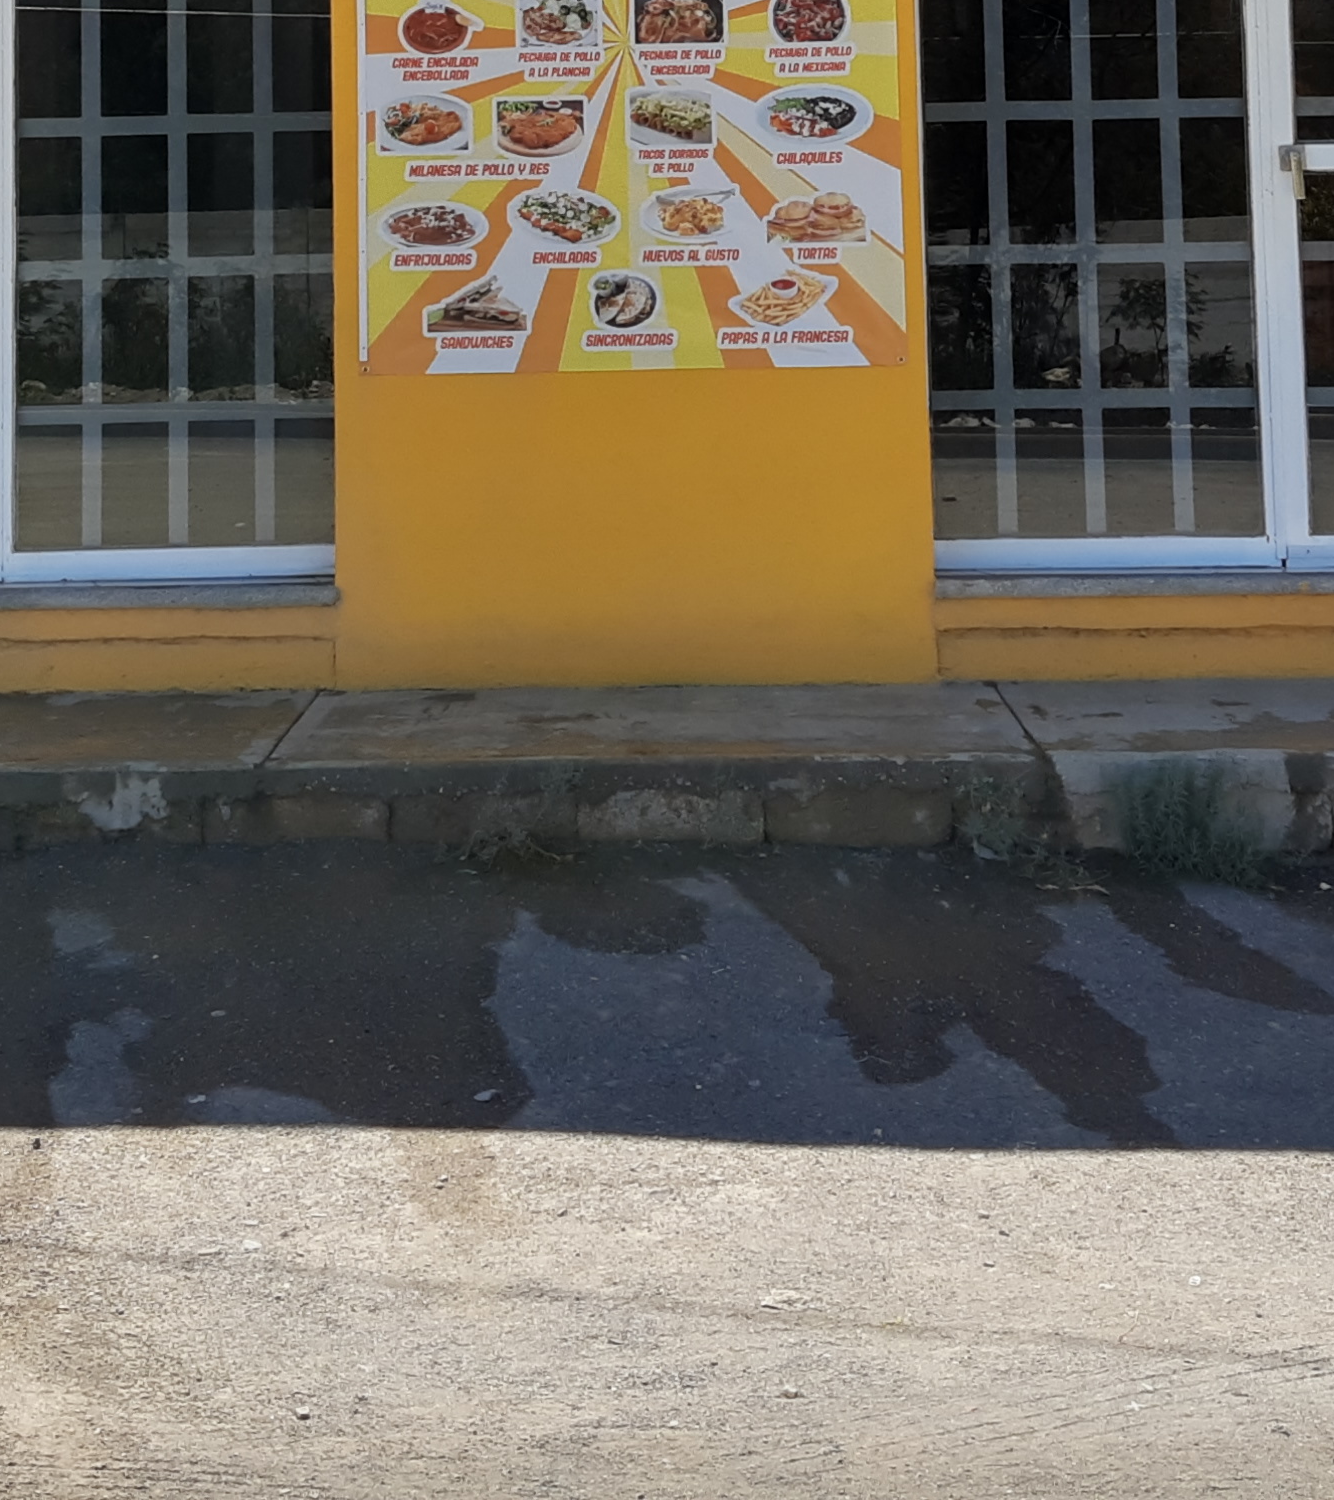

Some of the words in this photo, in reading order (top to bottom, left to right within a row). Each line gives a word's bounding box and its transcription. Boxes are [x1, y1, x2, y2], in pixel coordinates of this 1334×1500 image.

[518, 52, 557, 63] PECHUGA
[560, 52, 572, 62] DE
[574, 51, 601, 62] POLLO
[639, 50, 679, 61] PECHUGA
[681, 50, 693, 61] DE
[694, 49, 722, 60] POLLO
[769, 48, 809, 59] PECHUGA
[811, 47, 823, 57] DE
[825, 46, 852, 57] POLLO
[392, 57, 423, 69] CARNE
[426, 56, 479, 68] ENCHILADA
[779, 63, 786, 74] A
[788, 63, 800, 73] LA
[802, 62, 846, 73] MEXICANA
[402, 69, 469, 82] ENCEBOLLADA
[528, 68, 535, 78] A
[537, 68, 550, 77] LA
[551, 66, 591, 77] PLANCHA
[650, 64, 710, 76] ENCEBOLLADA
[638, 149, 665, 160] TACOS
[668, 149, 709, 160] DORADOS
[777, 152, 842, 166] CHILAQUILES
[409, 163, 461, 177] MILANESA
[464, 163, 479, 176] DE
[481, 163, 515, 176] POLLO
[518, 163, 527, 175] Y
[528, 162, 550, 175] RES
[652, 163, 665, 174] DE
[667, 162, 694, 173] POLLO
[394, 253, 473, 267] ENFRIJOLADAS
[532, 251, 597, 264] ENCHILADAS
[642, 249, 684, 263] HUEVOS
[687, 249, 701, 262] AL
[704, 248, 740, 261] GUSTO
[797, 247, 838, 260] TORTAS
[440, 336, 514, 350] SANDWICHES
[586, 333, 674, 348] SINCRONIZADAS
[721, 332, 758, 345] PAPAS
[761, 331, 770, 344] A
[773, 331, 788, 344] LA
[791, 330, 849, 343] FRANCESA
